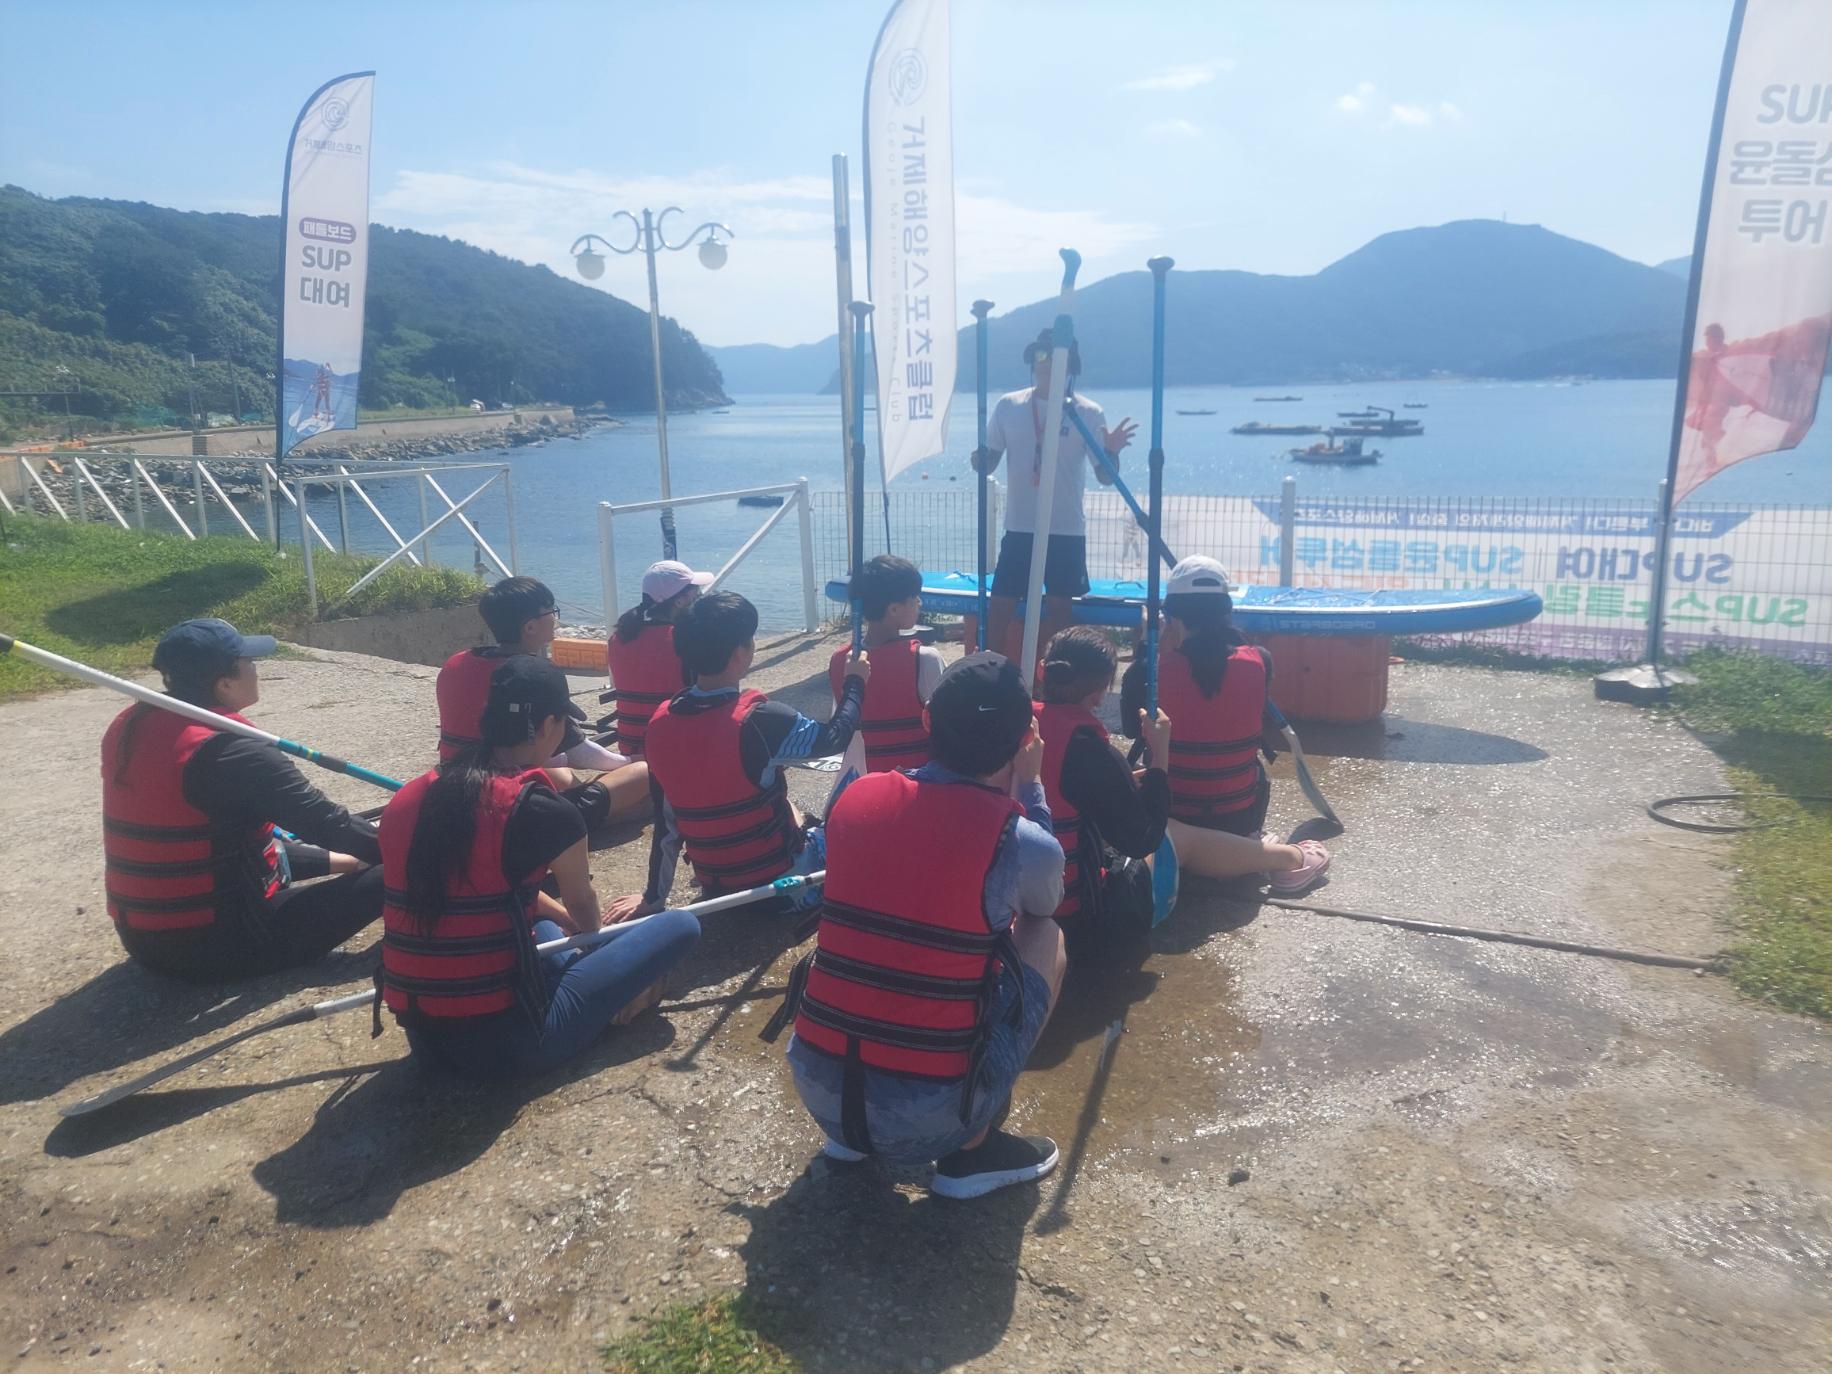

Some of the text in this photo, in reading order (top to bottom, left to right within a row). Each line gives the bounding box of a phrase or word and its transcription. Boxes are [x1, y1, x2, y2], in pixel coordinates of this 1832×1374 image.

[303, 221, 353, 241] 패들보드
[1738, 199, 1828, 244] 투어
[302, 245, 352, 272] SUP
[902, 116, 933, 421] 거제해양스포츠클럽
[299, 276, 351, 308] 대여
[891, 376, 901, 423] Club
